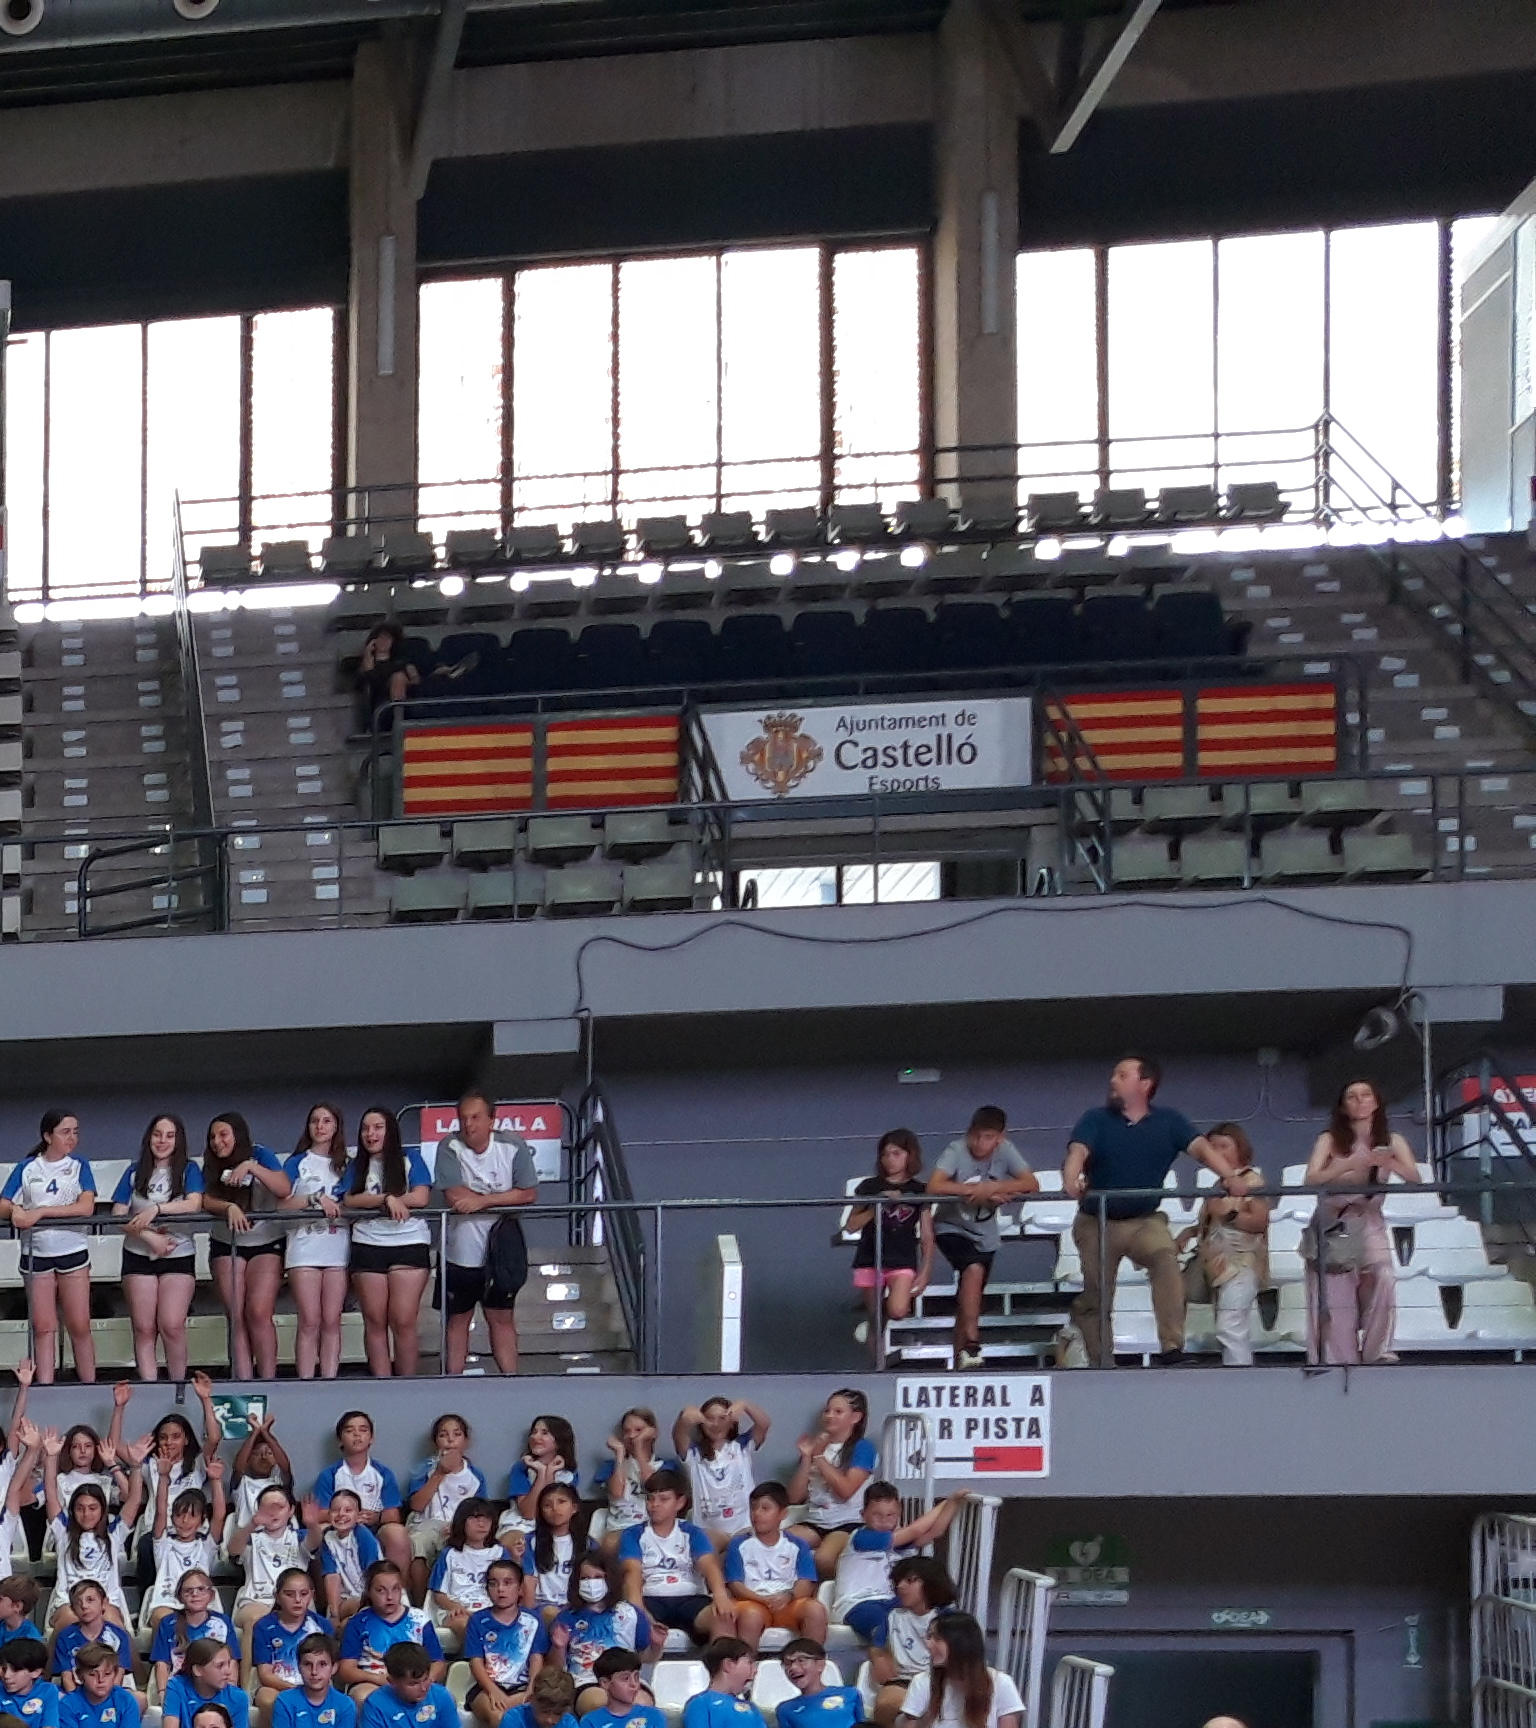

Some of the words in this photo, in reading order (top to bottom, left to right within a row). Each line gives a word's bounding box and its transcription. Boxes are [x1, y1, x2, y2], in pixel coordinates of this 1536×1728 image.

[835, 714, 946, 736] Ajuntament
[954, 709, 978, 726] de
[834, 732, 978, 770] Castelló
[868, 775, 941, 791] Esports
[531, 1116, 547, 1130] A
[45, 1178, 58, 1194] 4
[902, 1385, 1011, 1408] LATERAL
[1030, 1384, 1045, 1407] A
[906, 1418, 953, 1440] PR
[965, 1417, 1042, 1440] PISTA
[85, 1547, 95, 1559] 2
[273, 1555, 282, 1568] 5
[905, 1638, 913, 1650] 3
